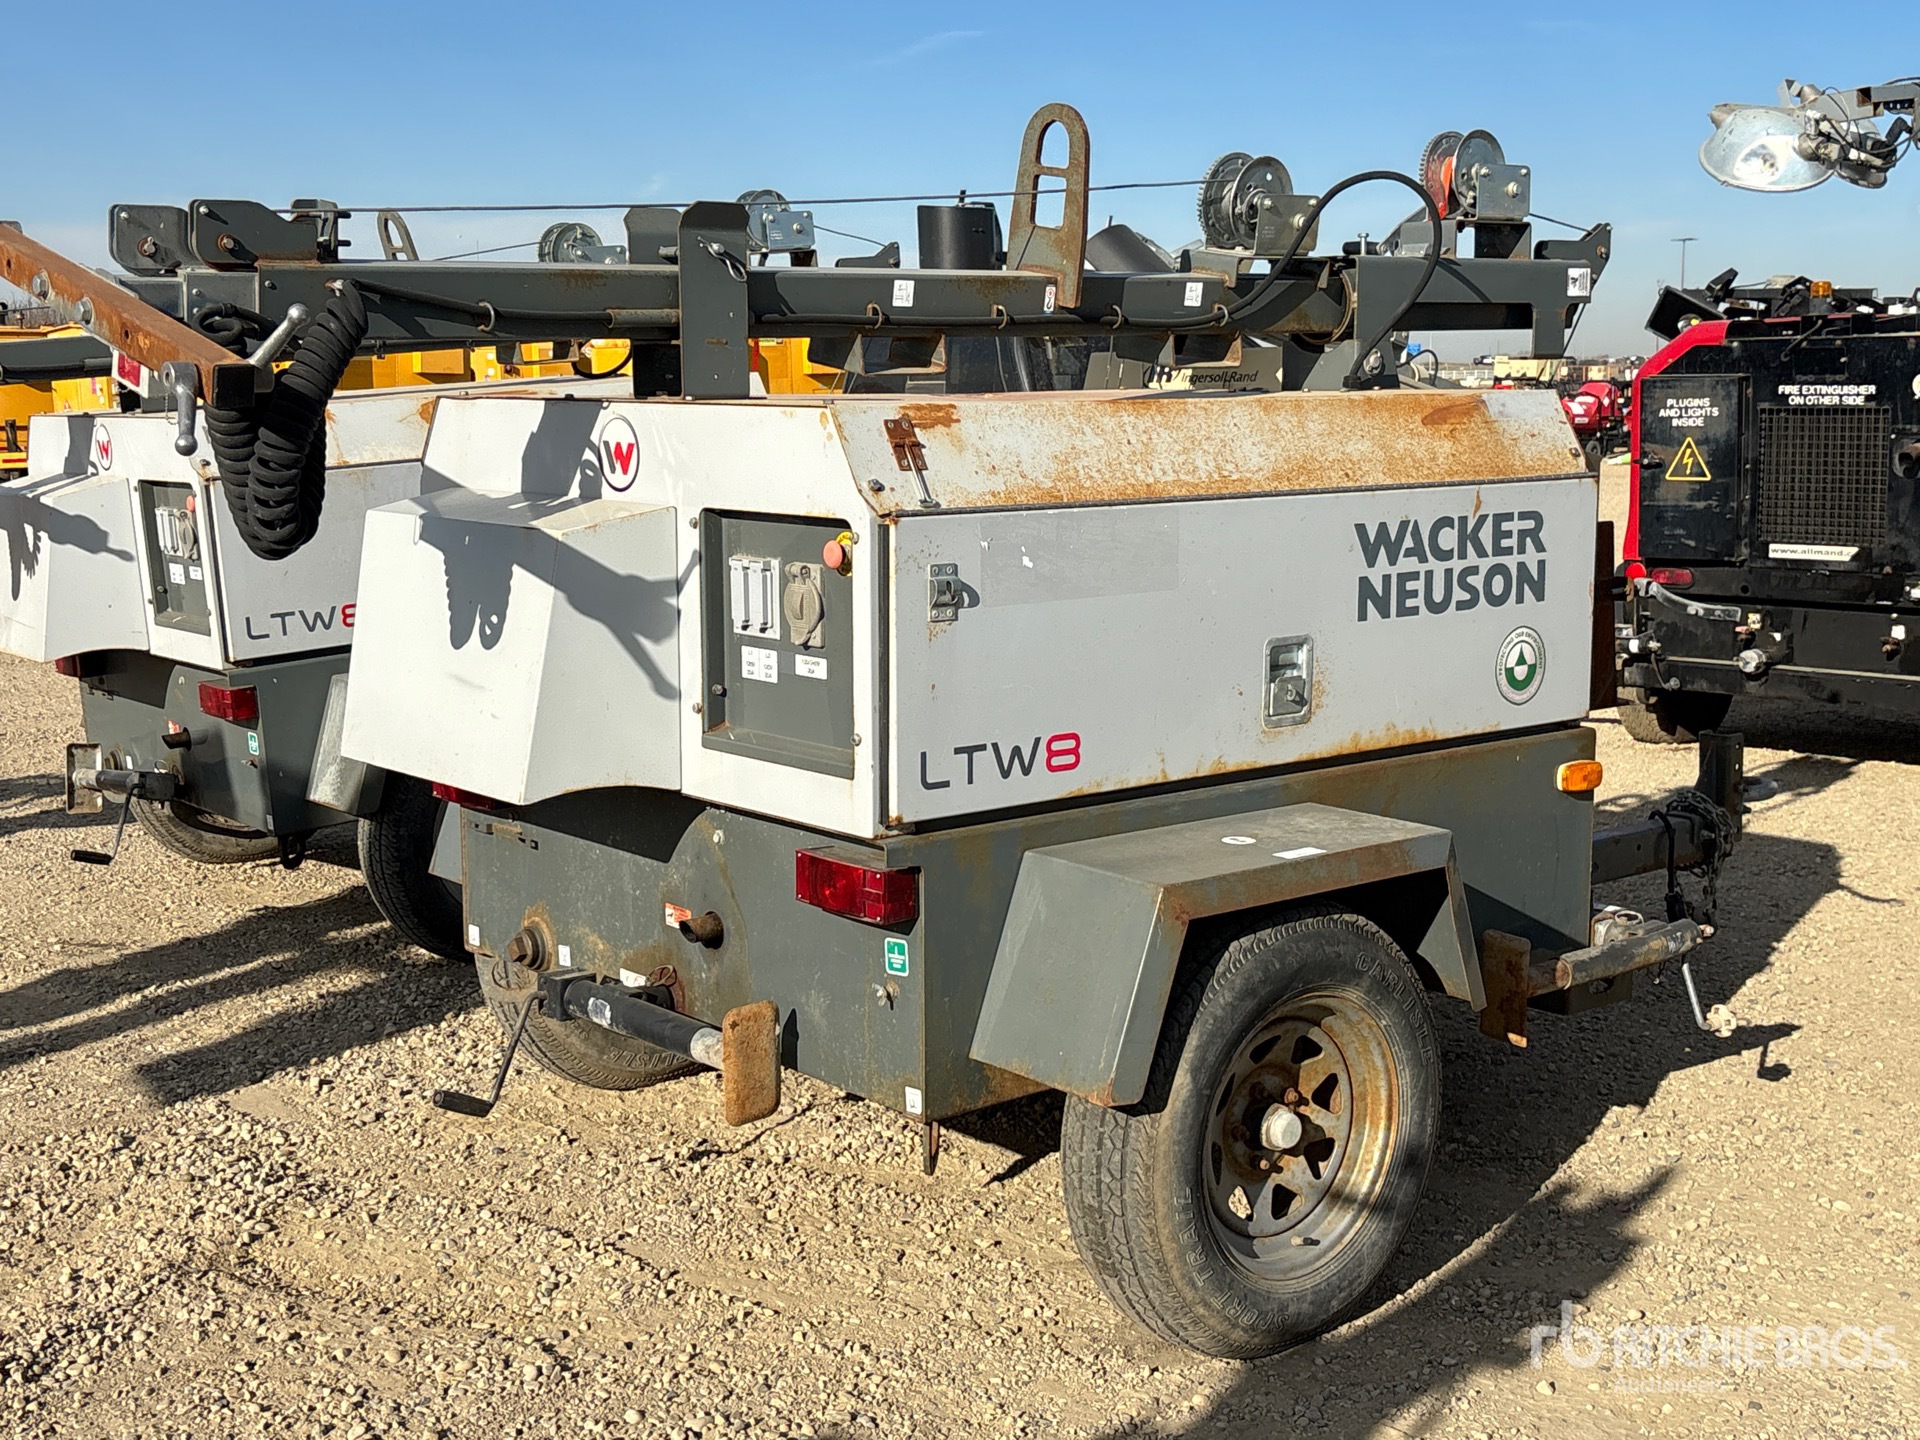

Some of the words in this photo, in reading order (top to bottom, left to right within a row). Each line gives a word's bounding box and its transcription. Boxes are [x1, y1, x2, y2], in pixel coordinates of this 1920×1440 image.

[1228, 370, 1259, 382] Rand
[1778, 385, 1800, 395] FIRE
[1801, 385, 1877, 395] EXTINGUISHER
[1659, 408, 1680, 417] AND
[1681, 407, 1719, 417] LIGHTS
[1666, 398, 1710, 408] PLUGINS
[1788, 395, 1804, 405] ON
[1805, 395, 1840, 405] OTHER
[1841, 395, 1865, 405] SIDE
[1671, 417, 1705, 427] INSIDE
[1354, 510, 1547, 569] WACKER
[1357, 559, 1546, 623] NEUSON
[920, 732, 1081, 791] LTW8
[1355, 951, 1434, 1066] CARLISLE
[1172, 1186, 1215, 1288] TRAIL
[1210, 1289, 1289, 1333] SPORT
